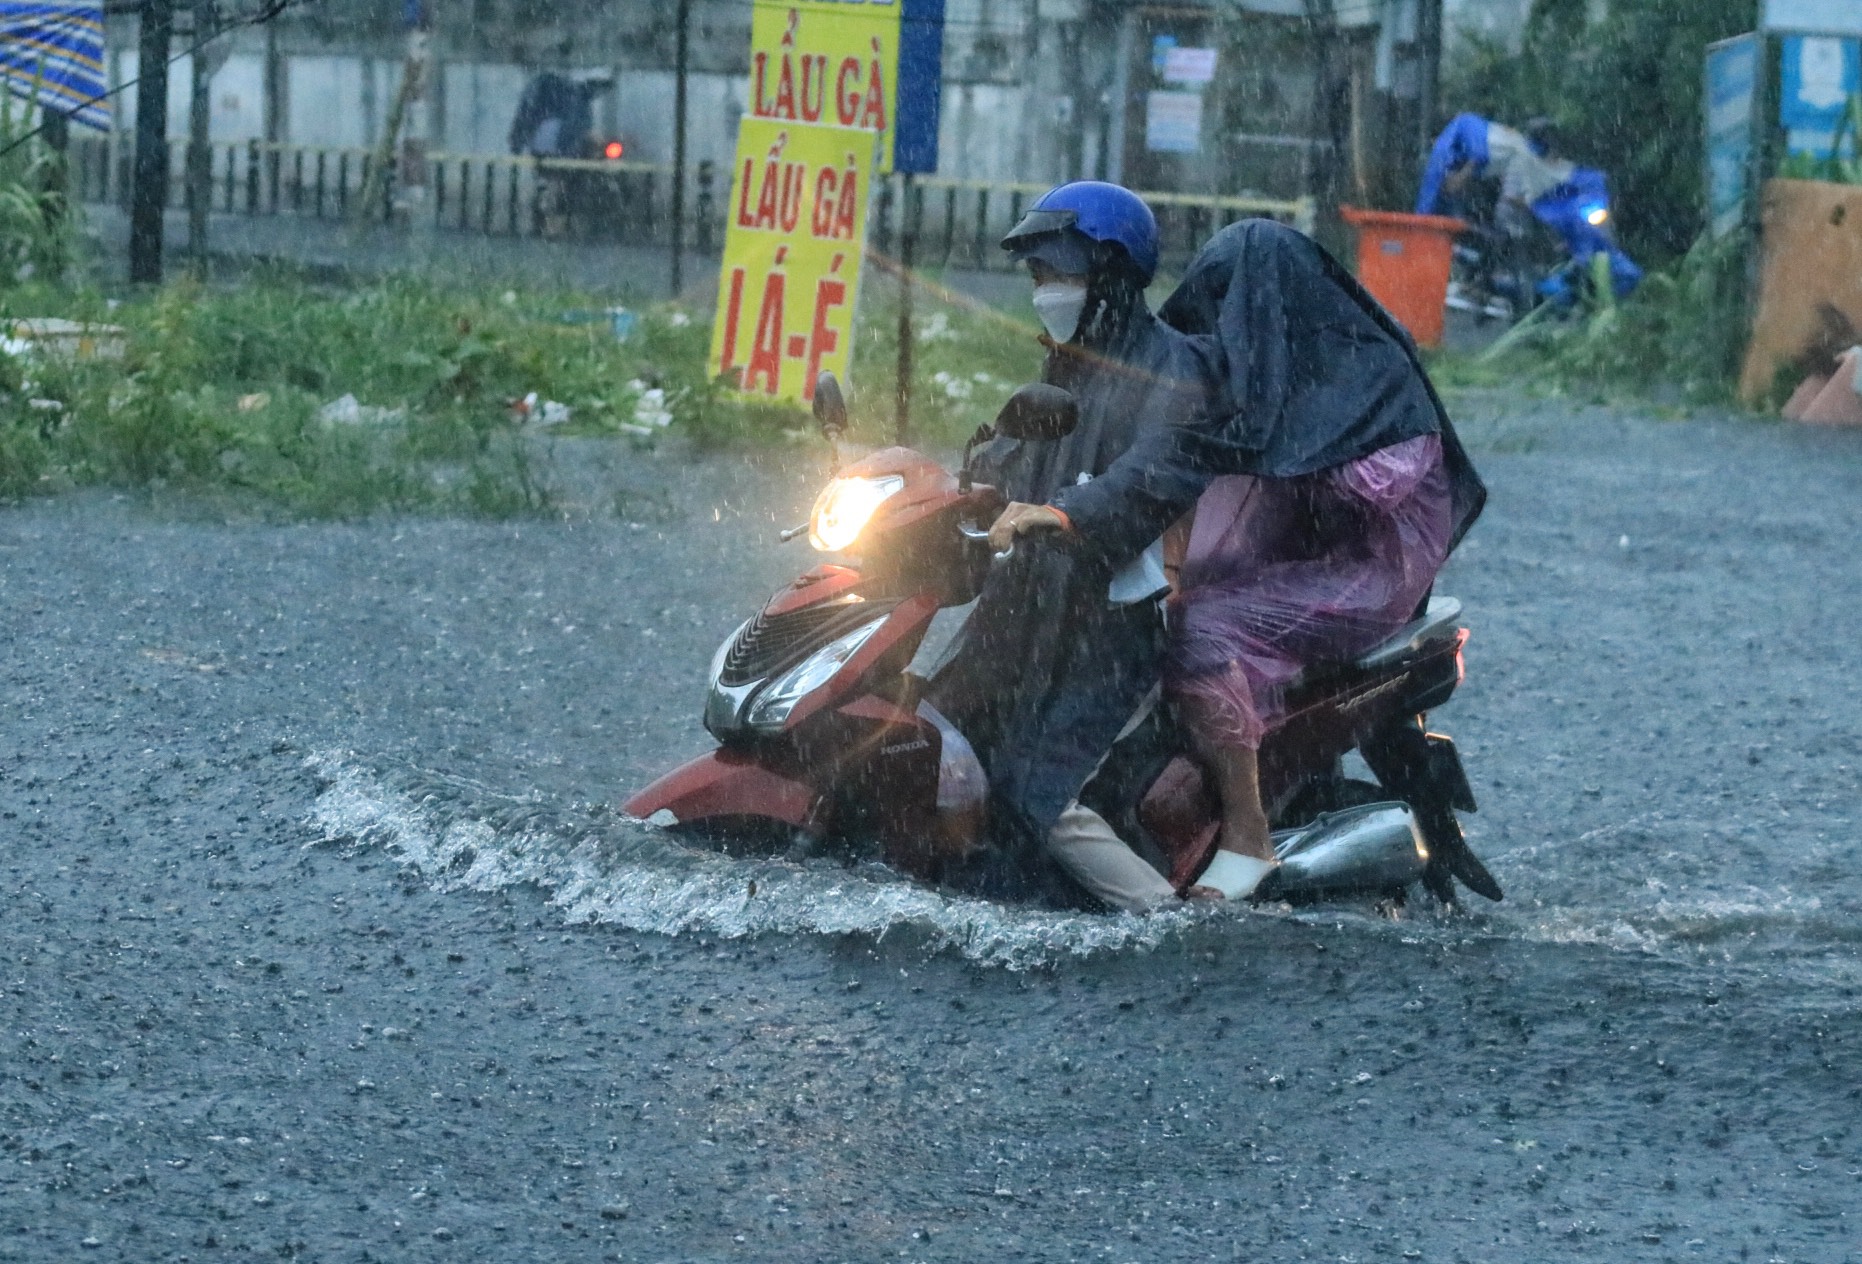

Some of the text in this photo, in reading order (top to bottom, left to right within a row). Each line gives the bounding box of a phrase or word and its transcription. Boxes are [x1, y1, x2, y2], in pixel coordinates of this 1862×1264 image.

[836, 36, 886, 131] GÀ
[812, 153, 857, 240] GÀ
[880, 740, 929, 755] HONDA
